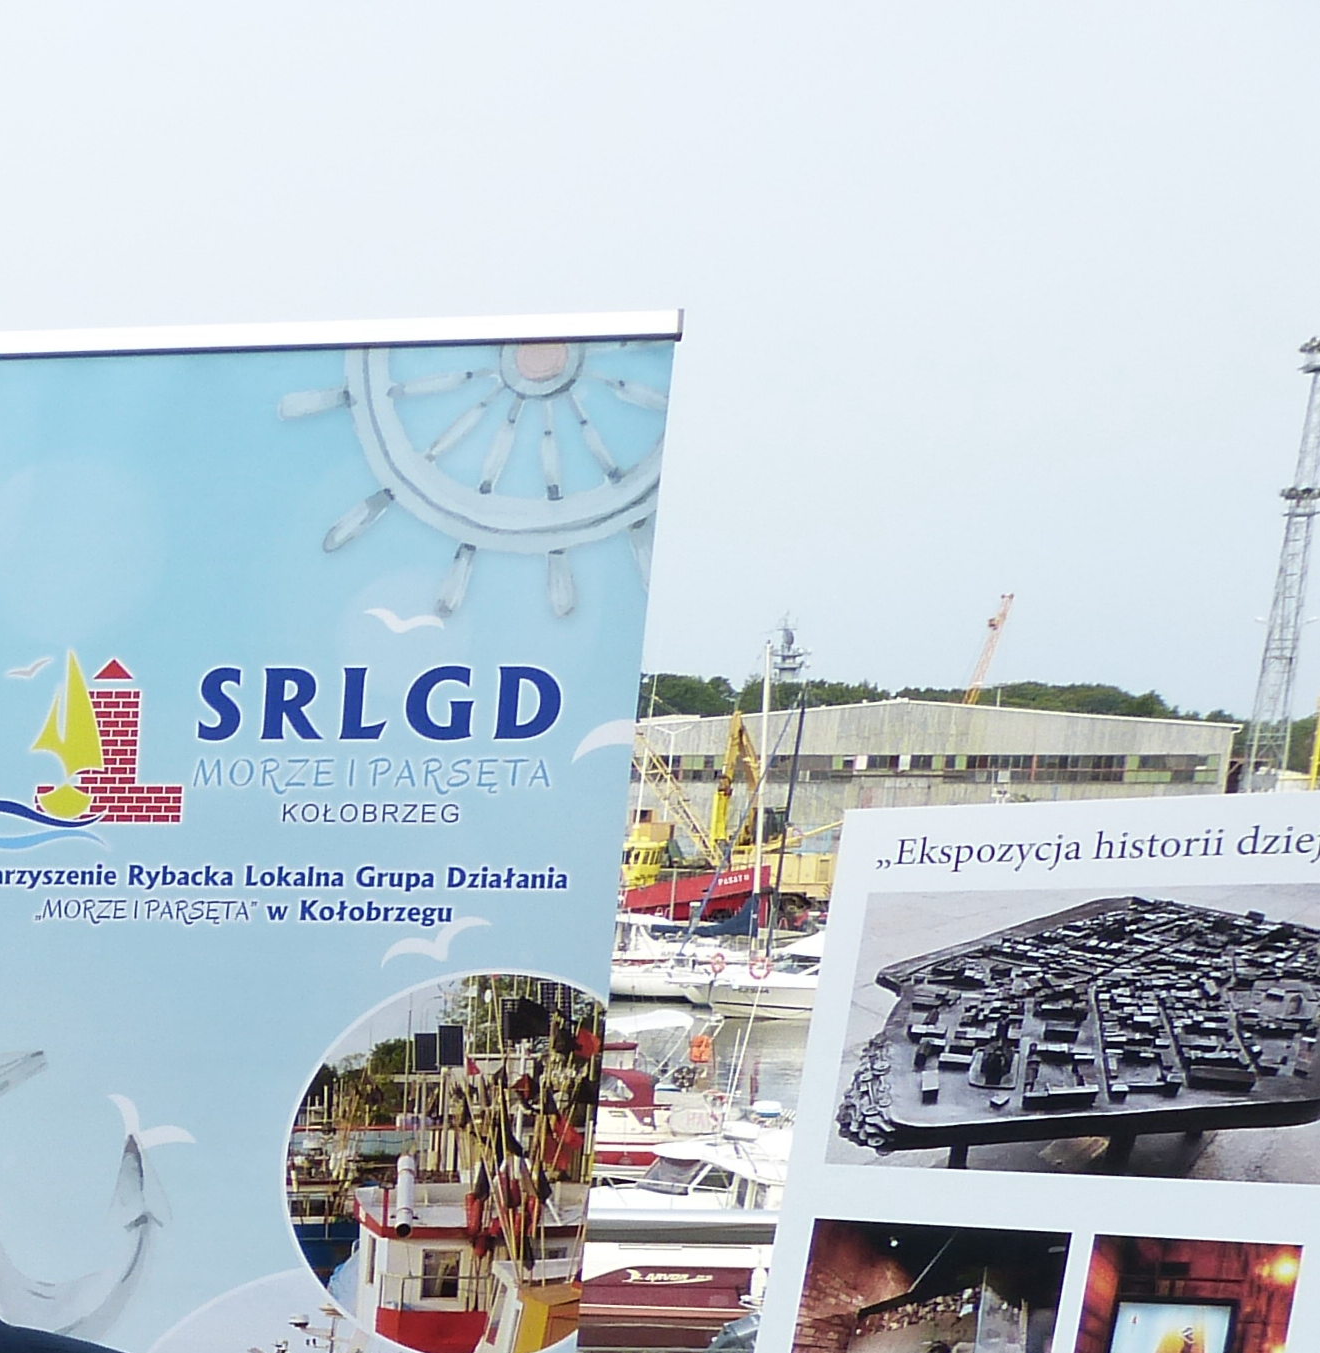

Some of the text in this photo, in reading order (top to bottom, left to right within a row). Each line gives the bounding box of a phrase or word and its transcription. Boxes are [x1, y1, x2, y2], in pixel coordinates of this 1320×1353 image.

[197, 665, 562, 741] SRLGD
[193, 757, 551, 795] MORZE I PARSĘTA
[282, 803, 460, 824] KOŁOBRZEG
[876, 833, 1081, 872] „Ekspozycja
[1091, 828, 1225, 860] historii
[127, 865, 233, 890] Rybacka
[245, 866, 344, 888] Lokalna
[356, 866, 435, 892] Grupa
[446, 866, 568, 889] Działania
[267, 904, 288, 921] w
[299, 899, 453, 927] Kołobrzegu
